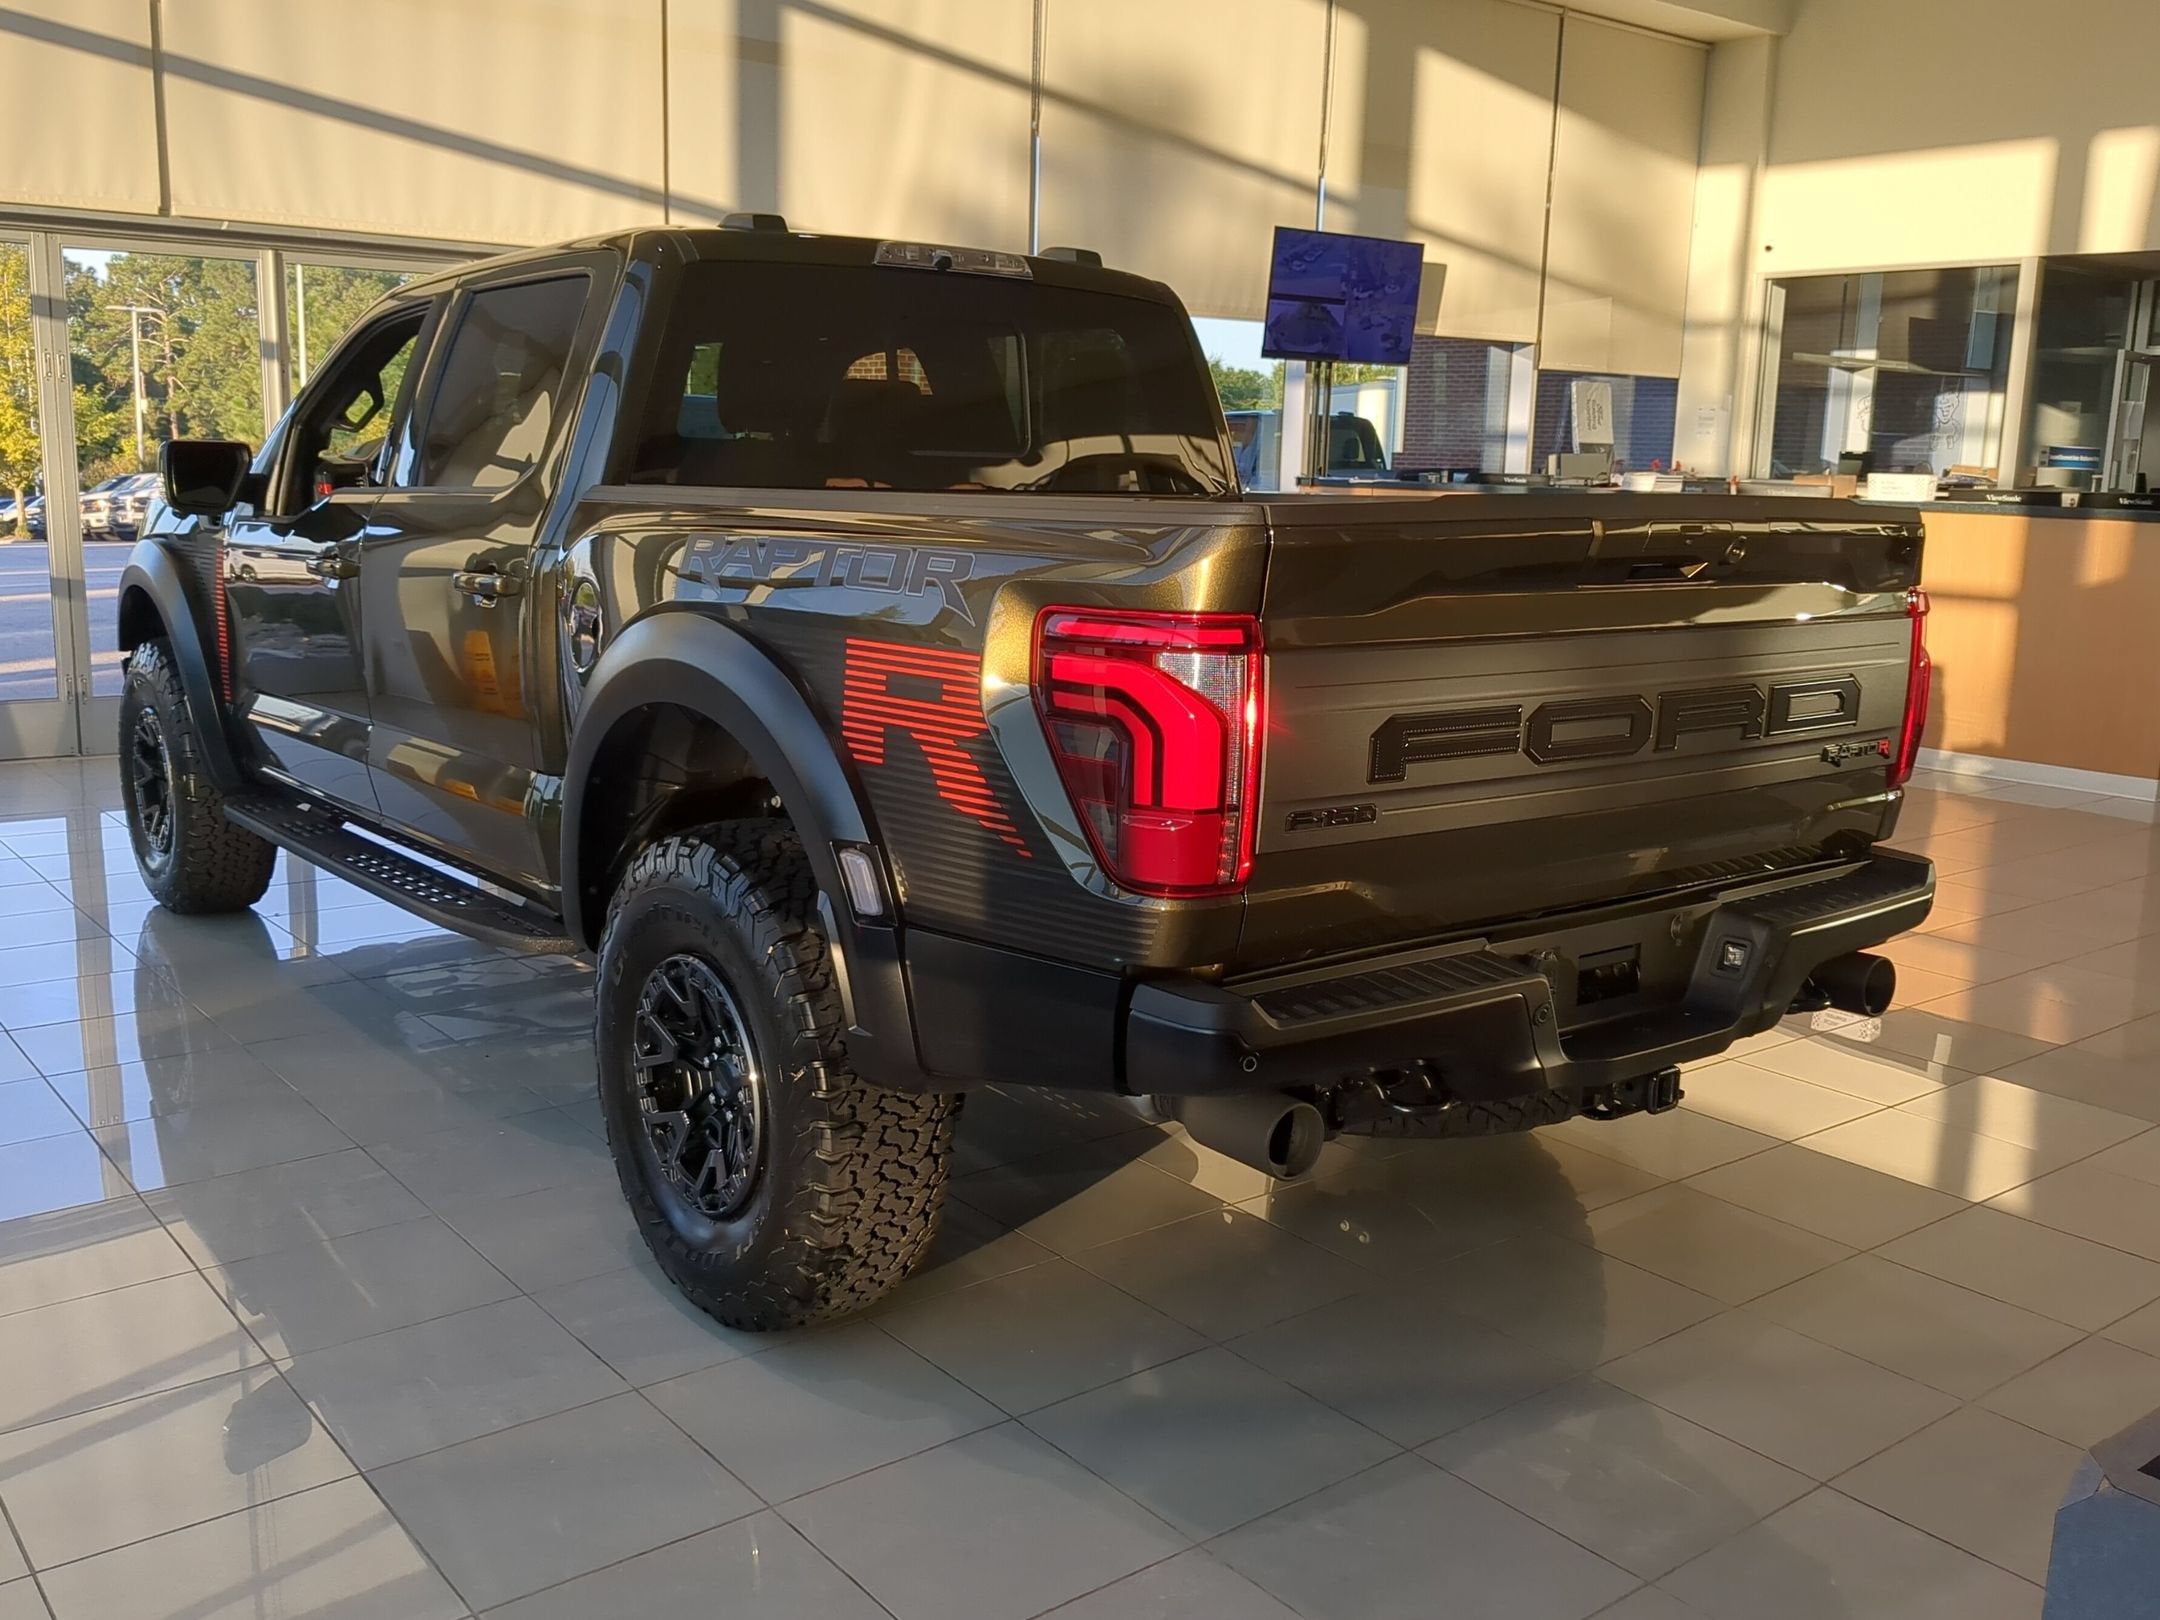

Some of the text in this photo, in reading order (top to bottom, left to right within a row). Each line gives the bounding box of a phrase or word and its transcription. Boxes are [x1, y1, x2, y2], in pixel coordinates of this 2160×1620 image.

[1986, 494, 2022, 503] ViewSonic
[679, 531, 977, 628] RAPTOR
[1366, 673, 1861, 785] FORD
[1821, 737, 1890, 767] RAPTOR
